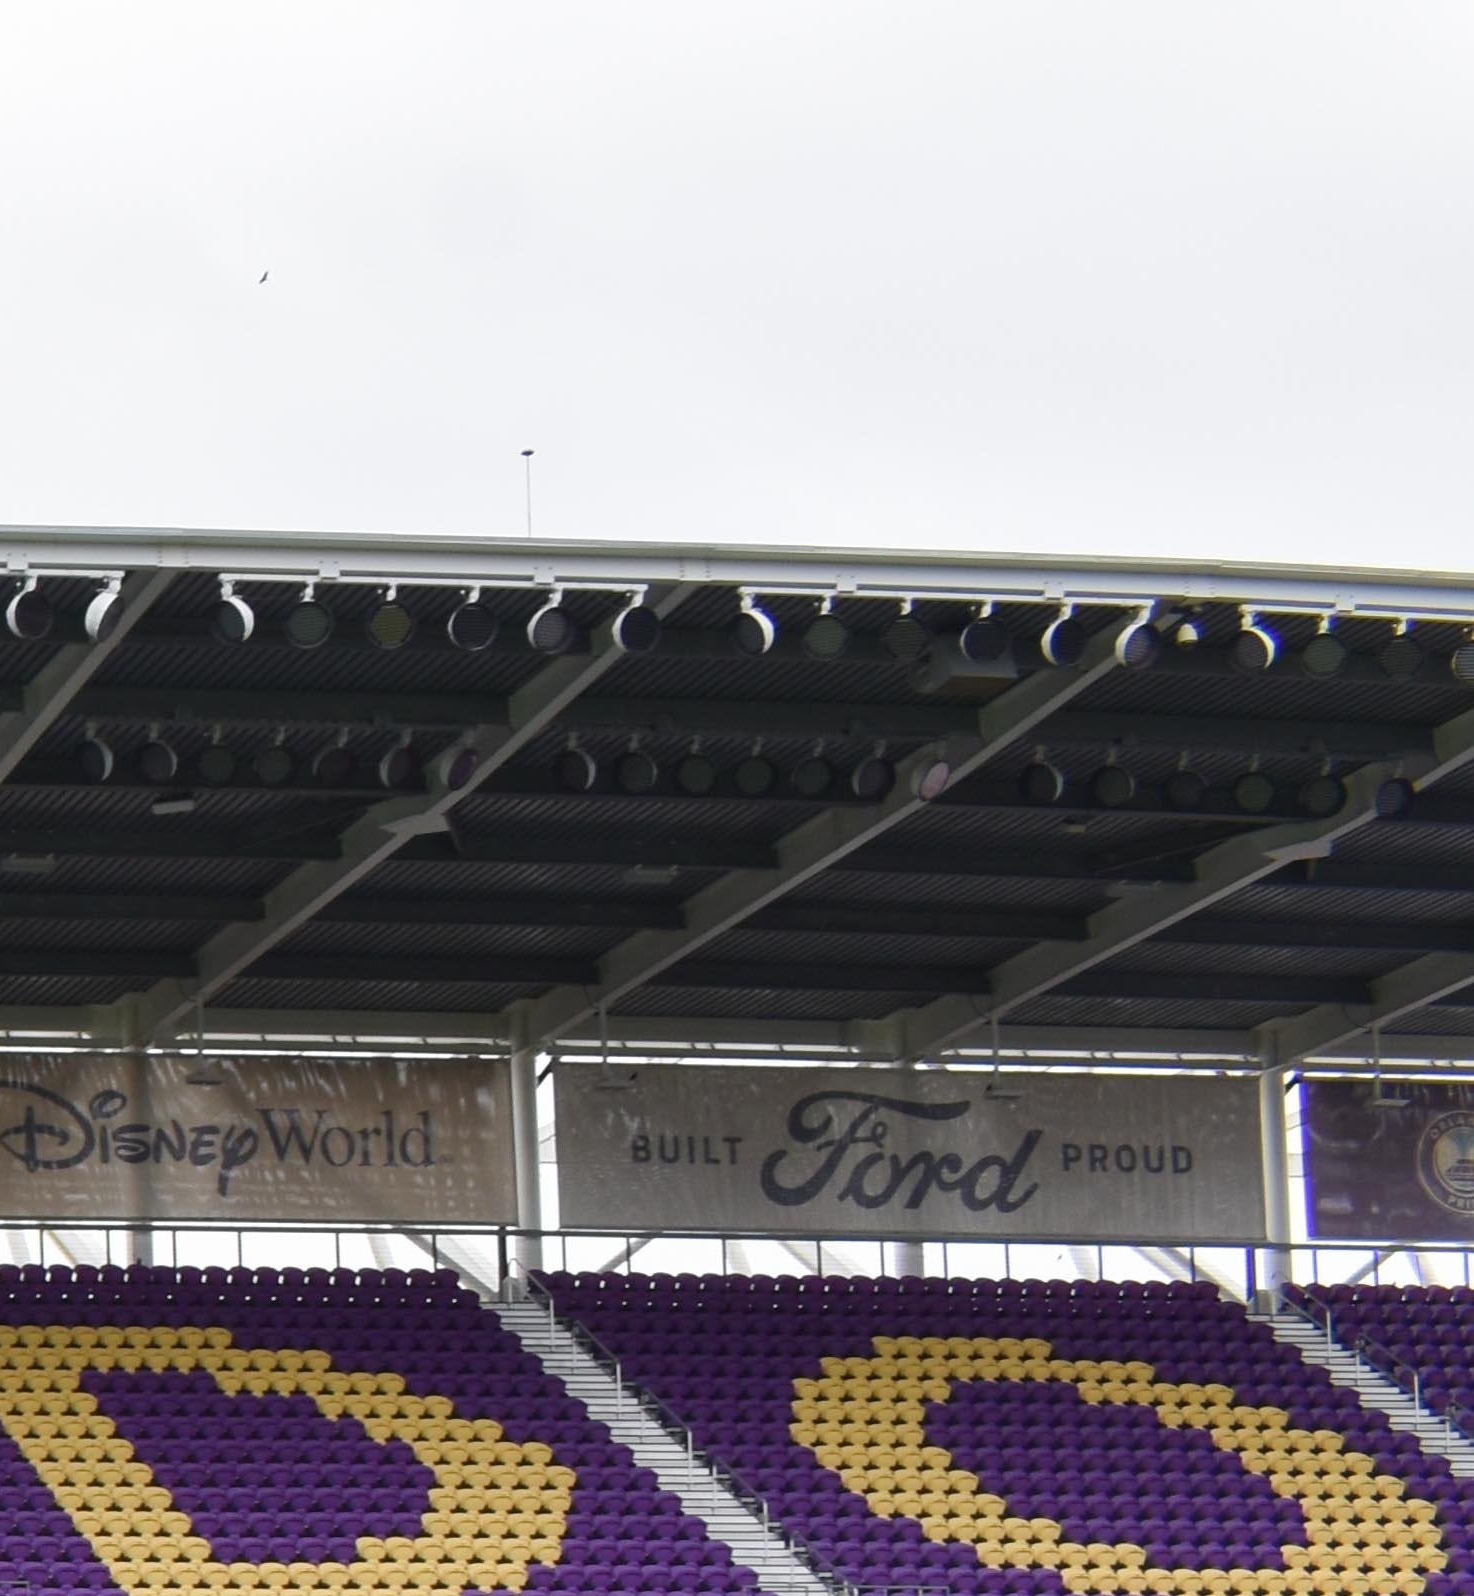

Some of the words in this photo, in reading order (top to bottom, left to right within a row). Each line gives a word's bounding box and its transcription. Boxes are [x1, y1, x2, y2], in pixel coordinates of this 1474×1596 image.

[258, 1108, 438, 1169] World
[632, 1134, 744, 1166] BUILT
[761, 1090, 1044, 1213] Ford
[1061, 1143, 1194, 1174] PROUD
